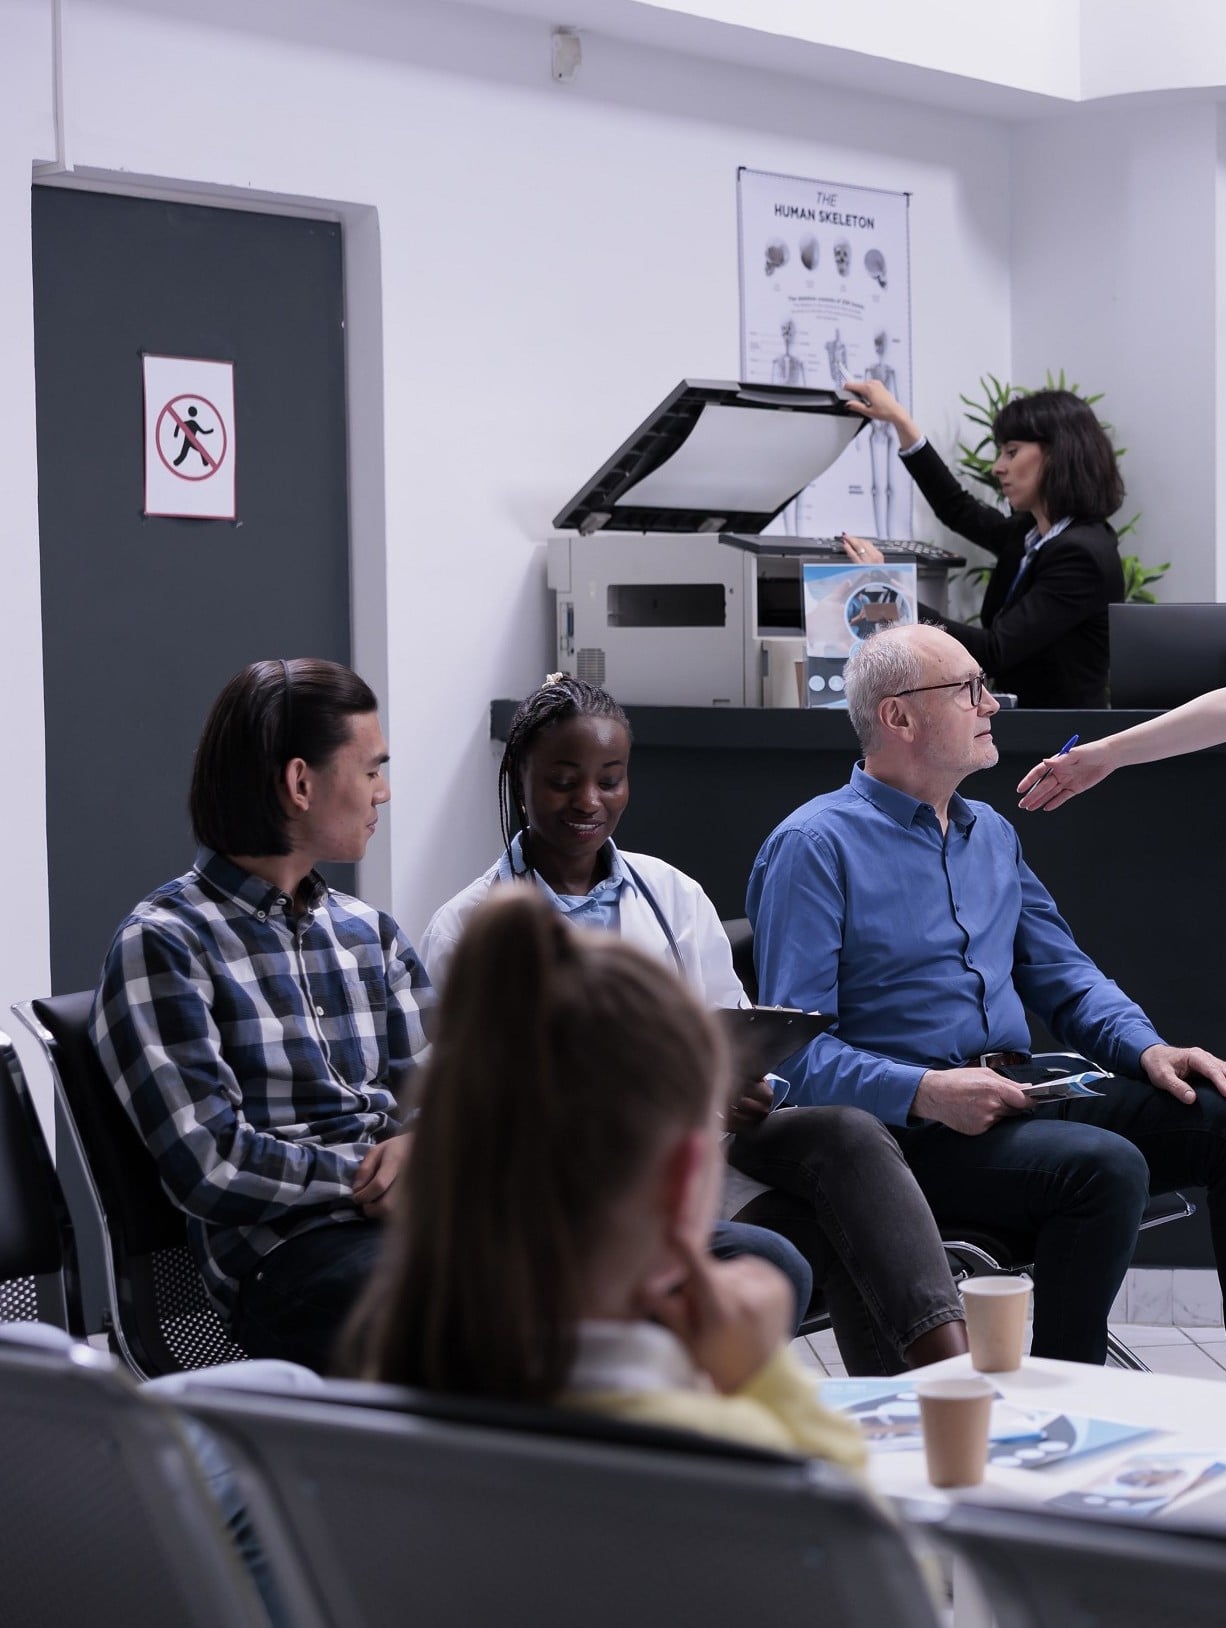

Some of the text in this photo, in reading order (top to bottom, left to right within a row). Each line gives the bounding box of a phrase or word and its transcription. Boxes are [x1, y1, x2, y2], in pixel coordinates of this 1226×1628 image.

[817, 191, 838, 207] THE
[774, 203, 875, 230] HUMAN SKELETON
